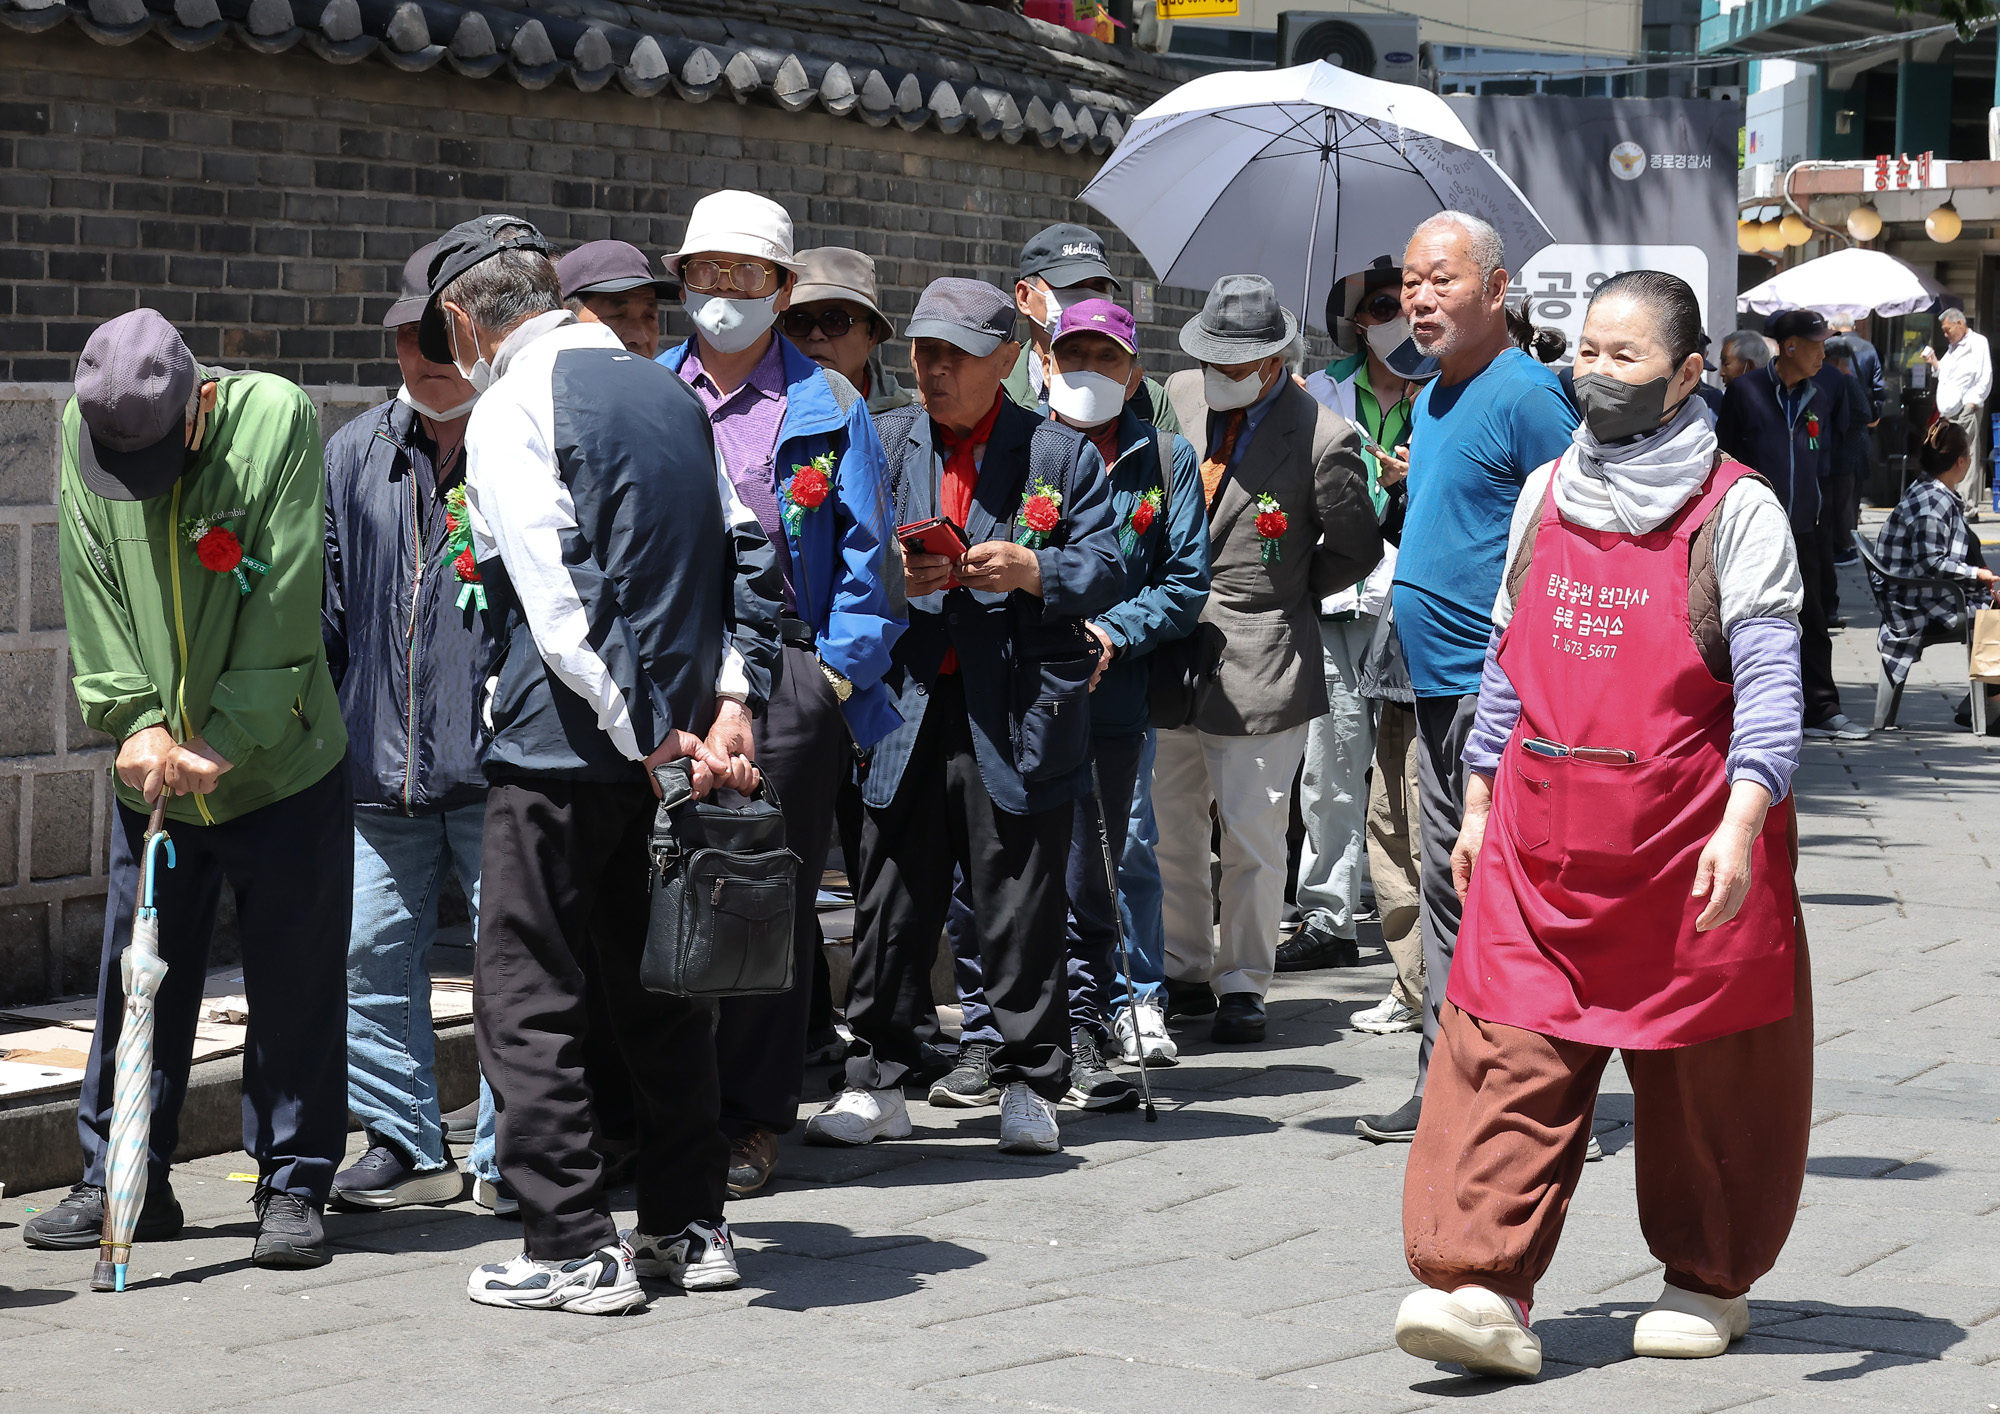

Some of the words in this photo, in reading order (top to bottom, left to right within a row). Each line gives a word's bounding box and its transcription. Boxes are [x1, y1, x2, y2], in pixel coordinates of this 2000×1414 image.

[1650, 154, 1712, 169] 종로경찰서
[1547, 574, 1594, 606] 탑골공원
[1598, 587, 1650, 609] 원각사
[1553, 606, 1574, 629] 무료
[1578, 613, 1623, 637] 급식소
[549, 1294, 566, 1304] FILA
